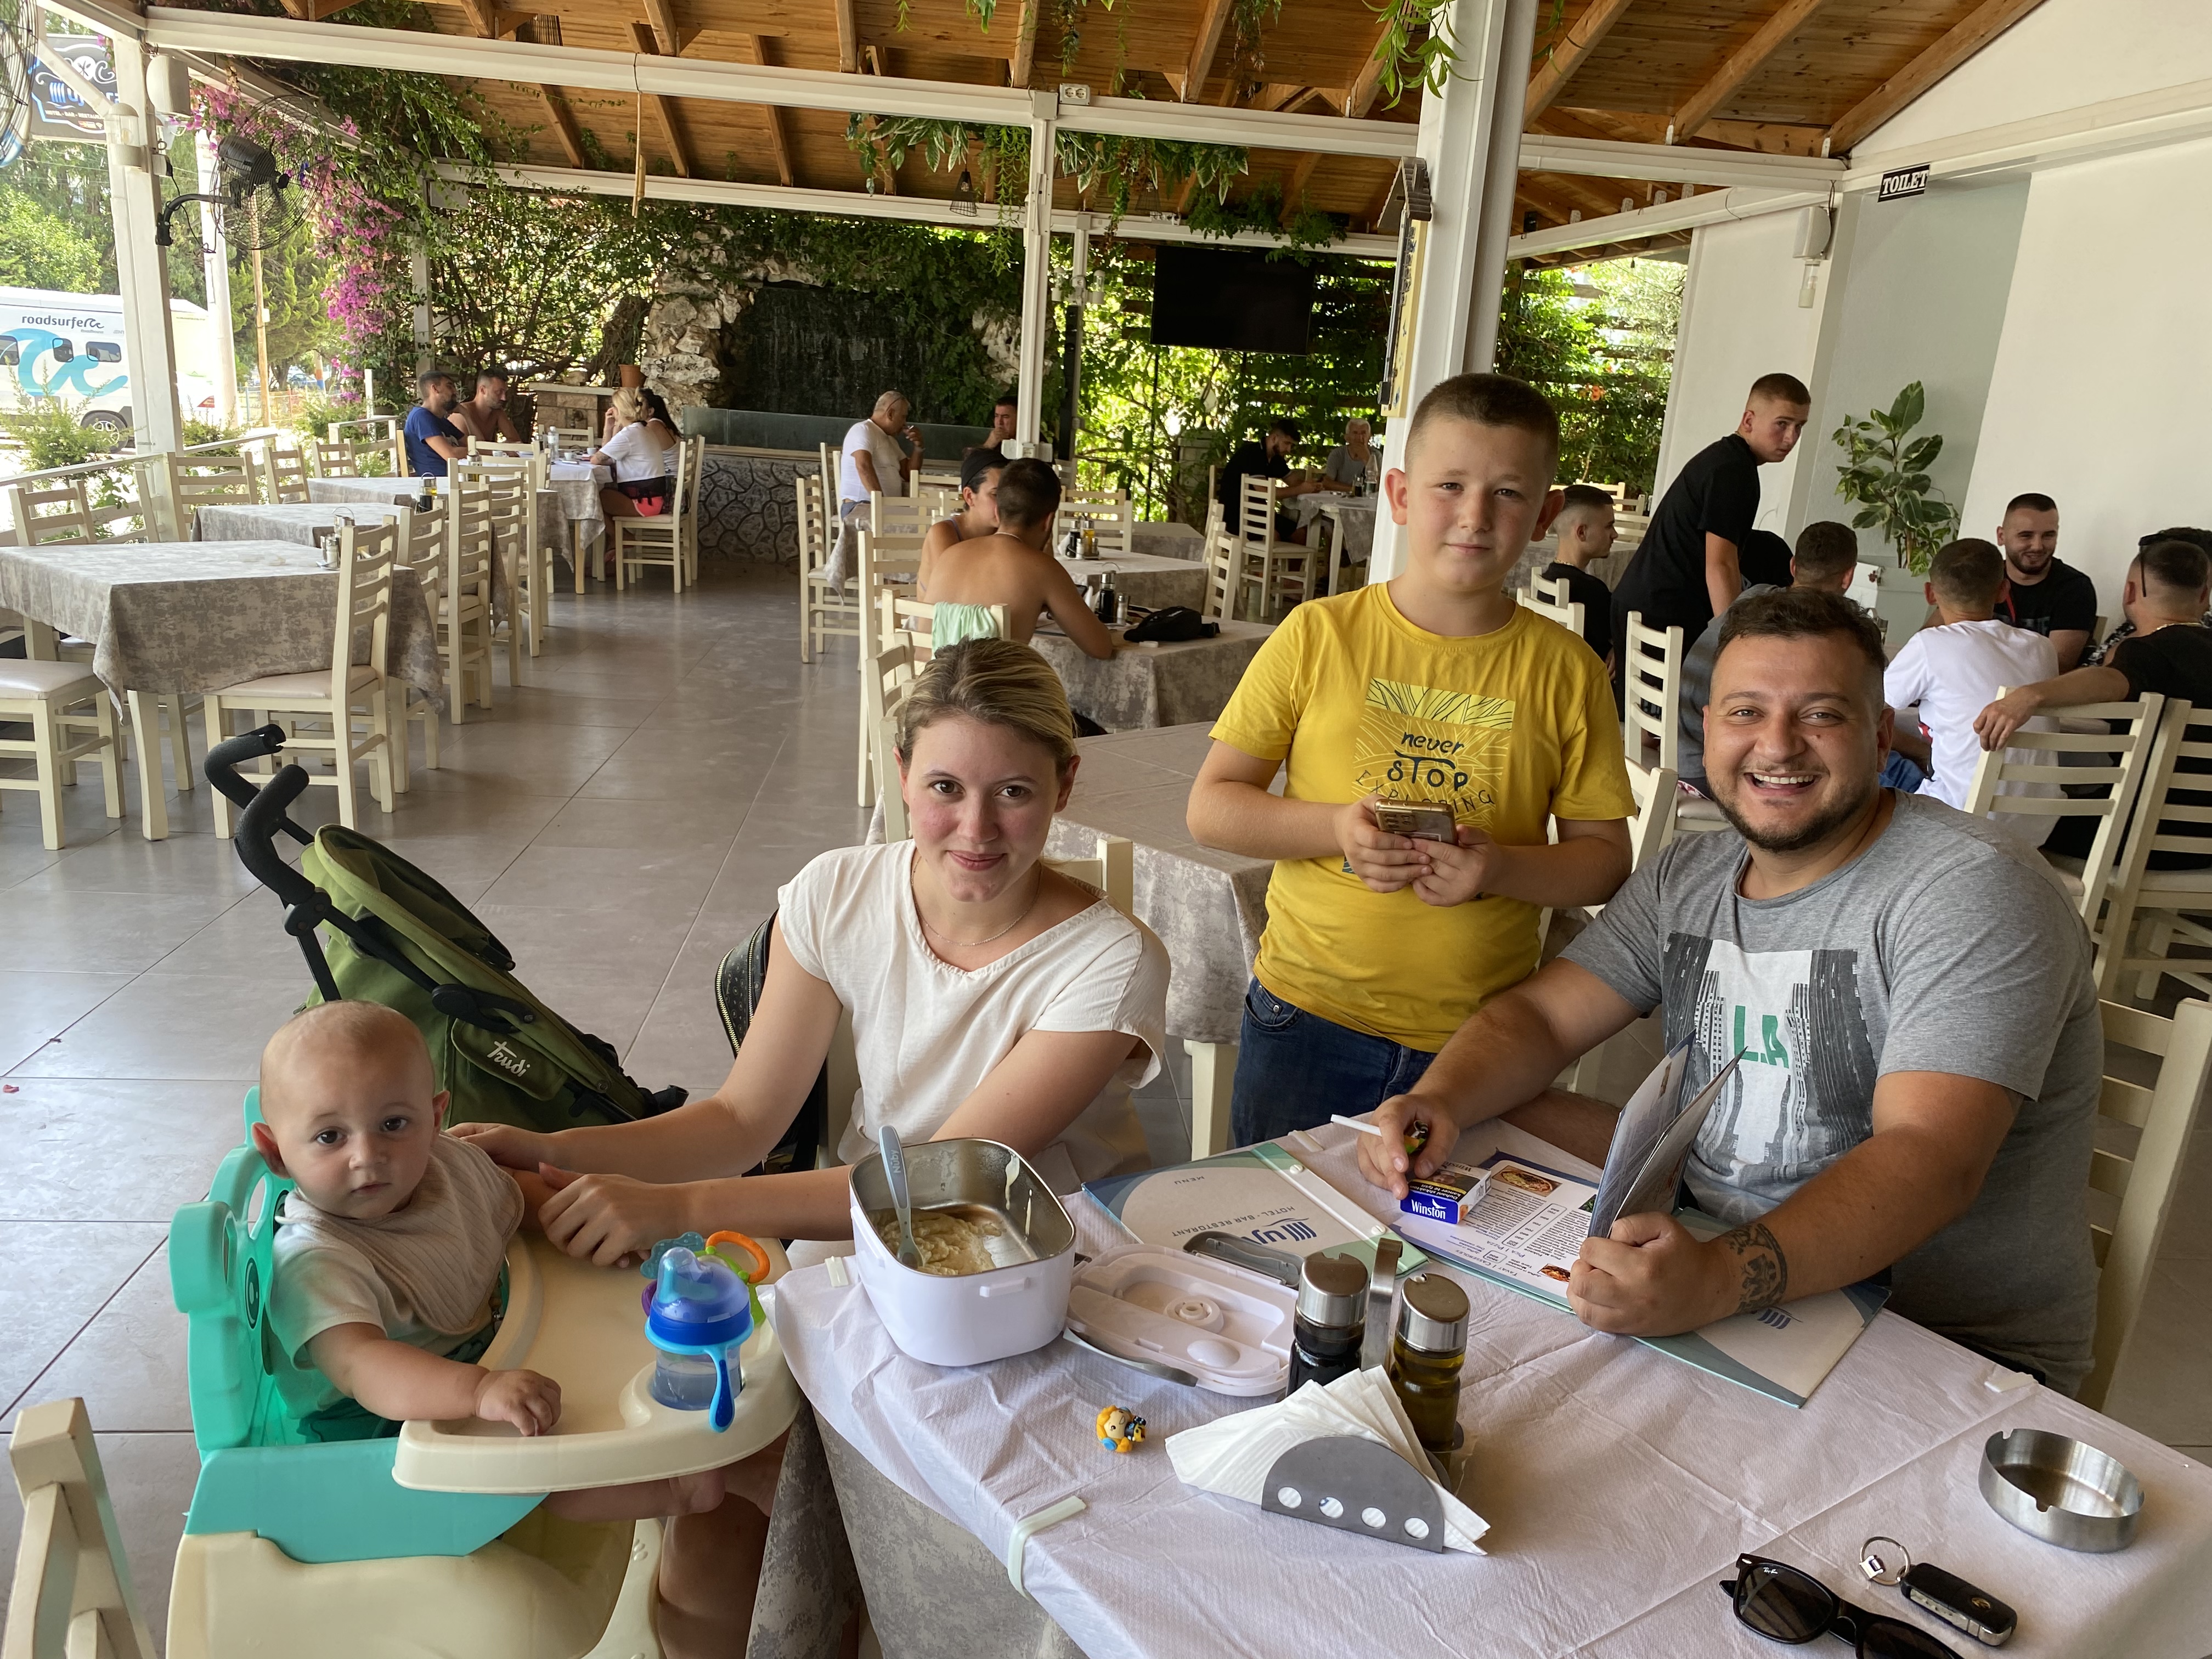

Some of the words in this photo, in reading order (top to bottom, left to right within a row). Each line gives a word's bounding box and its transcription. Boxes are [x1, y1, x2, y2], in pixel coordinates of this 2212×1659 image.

[1882, 170, 1929, 194] TOILET
[22, 315, 104, 329] roadsurfer
[1401, 731, 1464, 755] never
[1387, 750, 1468, 792] STOP
[1355, 770, 1496, 814] EXPING
[487, 1041, 531, 1077] Trudi
[1443, 1161, 1472, 1172] Winsto
[1174, 1176, 1205, 1185] MENU
[1436, 1191, 1458, 1200] Duhani
[1440, 1188, 1462, 1197] kancer
[1261, 1206, 1296, 1217] HOTEL
[1411, 1199, 1446, 1220] Winston
[1234, 1215, 1256, 1223] BAR
[1172, 1218, 1233, 1237] RESTORANT
[1487, 1241, 1504, 1250] PIZZA
[1498, 1267, 1517, 1276] TAVAT
